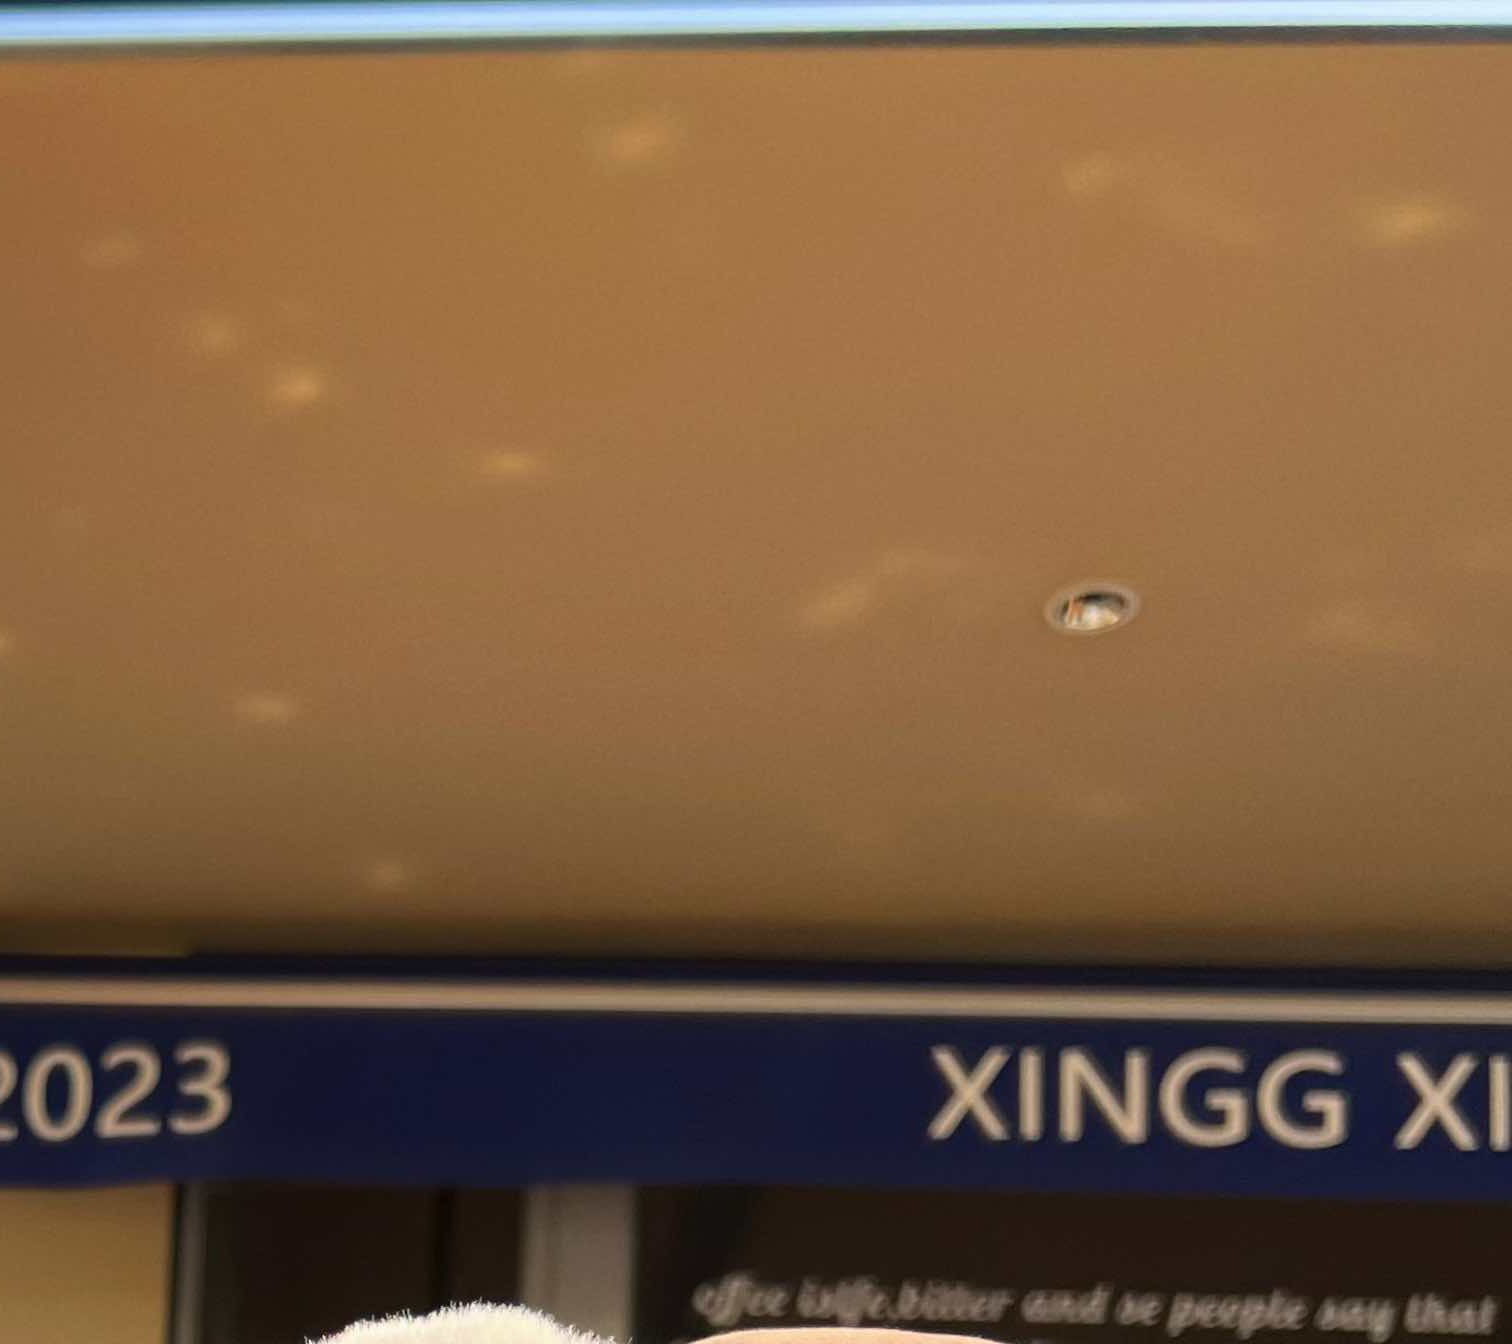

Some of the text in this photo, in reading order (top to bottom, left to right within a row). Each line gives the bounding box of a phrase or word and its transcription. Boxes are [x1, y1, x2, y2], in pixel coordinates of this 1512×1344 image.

[926, 1045, 1349, 1149] XINGG
[1021, 1283, 1114, 1325] and
[1166, 1289, 1310, 1339] people
[1402, 1293, 1498, 1335] that
